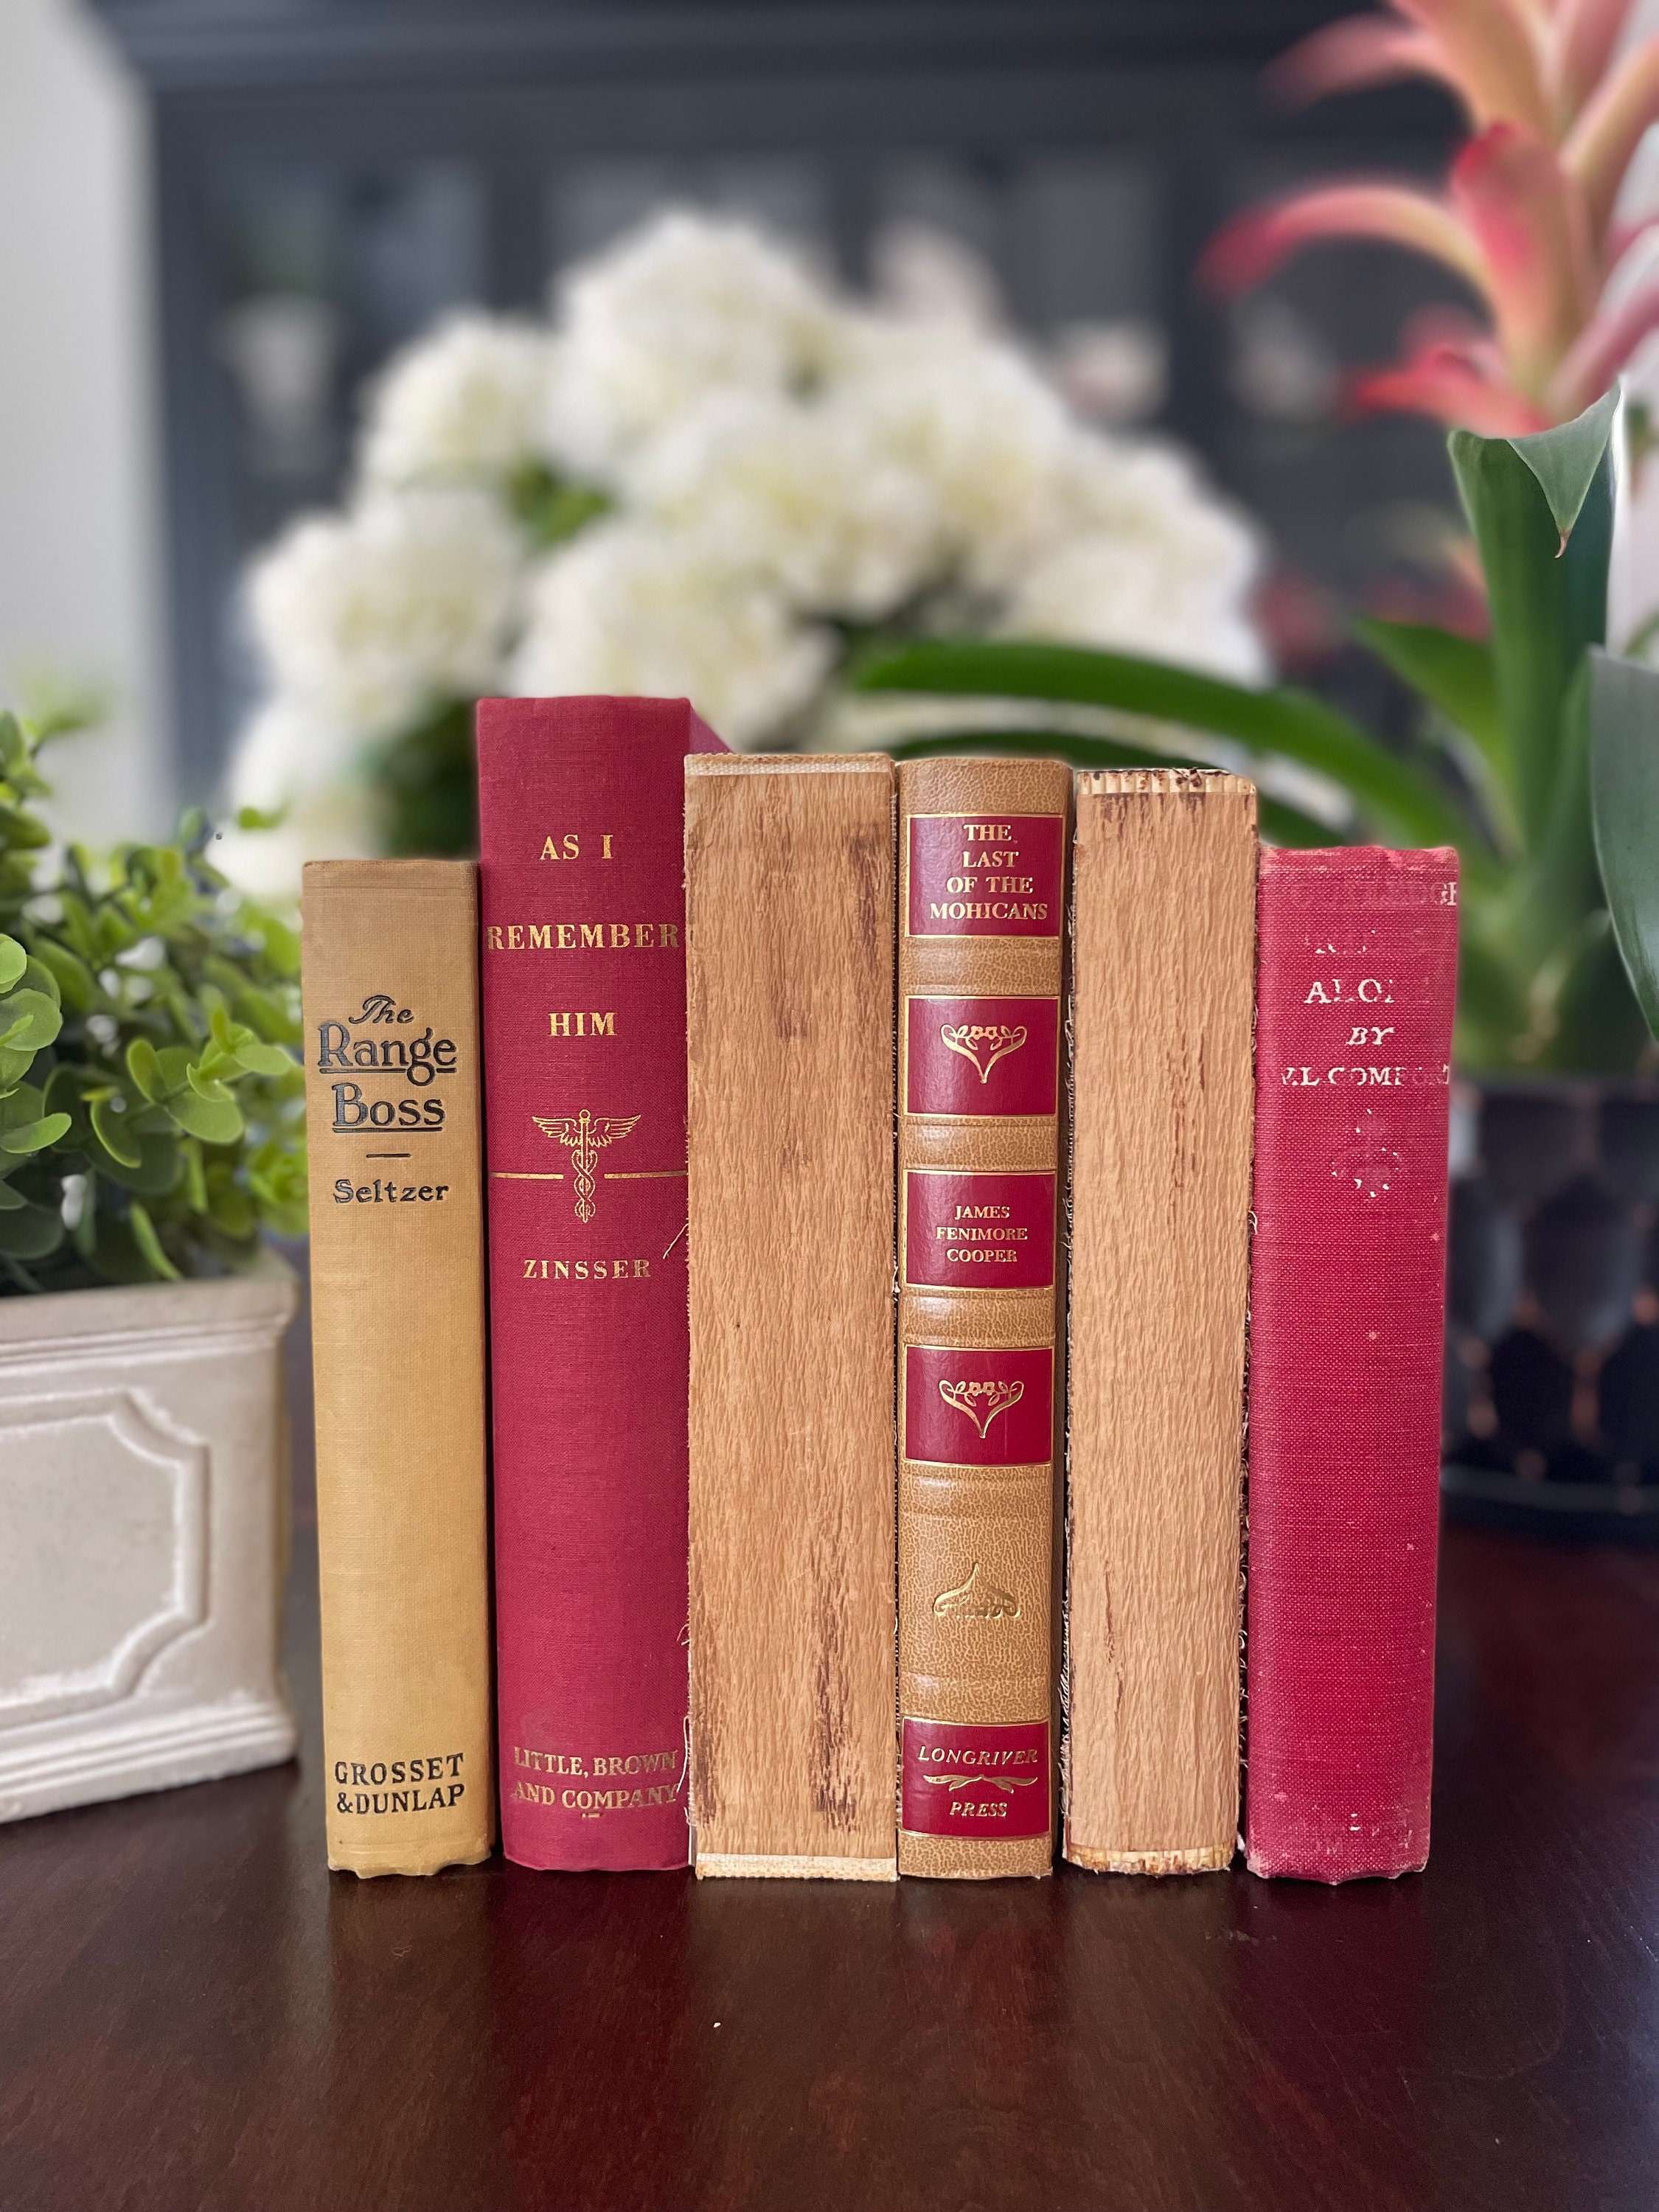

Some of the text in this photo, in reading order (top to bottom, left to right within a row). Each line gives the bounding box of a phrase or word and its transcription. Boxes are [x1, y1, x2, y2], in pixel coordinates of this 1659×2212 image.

[964, 824, 1012, 841] THE
[540, 834, 613, 860] AS I
[963, 850, 1020, 868] LAST
[946, 876, 1033, 894] OF THE
[930, 902, 1048, 920] MOHICANS
[487, 924, 680, 950] REMEMBER
[349, 995, 414, 1025] The
[549, 1012, 618, 1037] HIM
[1346, 1026, 1395, 1046] BY
[317, 1022, 458, 1087] Range
[332, 1082, 446, 1127] Boss
[333, 1179, 450, 1204] Seltzer
[954, 1205, 1011, 1220] JAMES
[936, 1226, 1029, 1241] FENIMORE
[946, 1248, 1018, 1263] COOPER
[523, 1259, 651, 1280] ZINSSER
[514, 1746, 678, 1778] LITTLE, BROWN
[918, 1745, 1038, 1766] LONGRIVER
[334, 1752, 465, 1786] GROSSET
[512, 1781, 679, 1810] AND COMPANY
[949, 1801, 1008, 1818] PRESS
